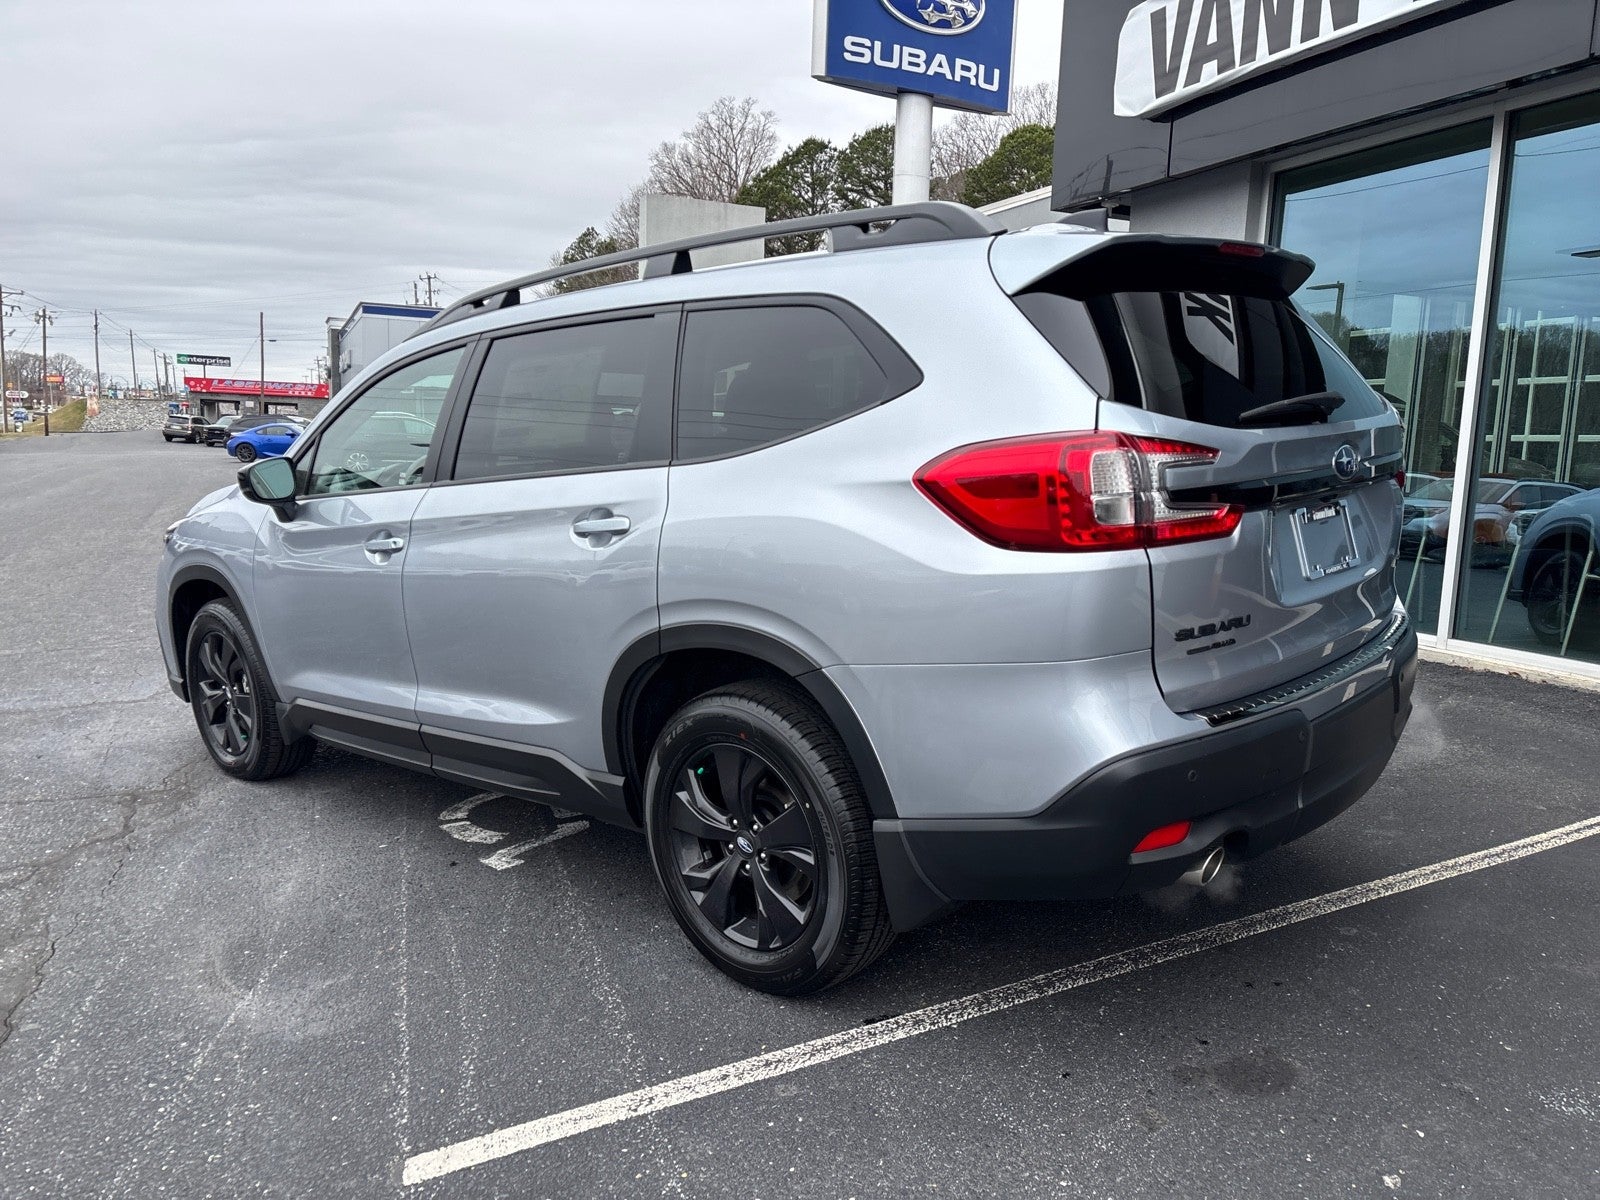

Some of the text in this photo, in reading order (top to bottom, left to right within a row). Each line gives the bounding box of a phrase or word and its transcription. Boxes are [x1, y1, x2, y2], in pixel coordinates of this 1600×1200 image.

[843, 35, 1000, 92] SUBARU
[179, 356, 230, 364] enterprise
[1174, 614, 1251, 642] SUBARU
[664, 718, 694, 747] ZIEX
